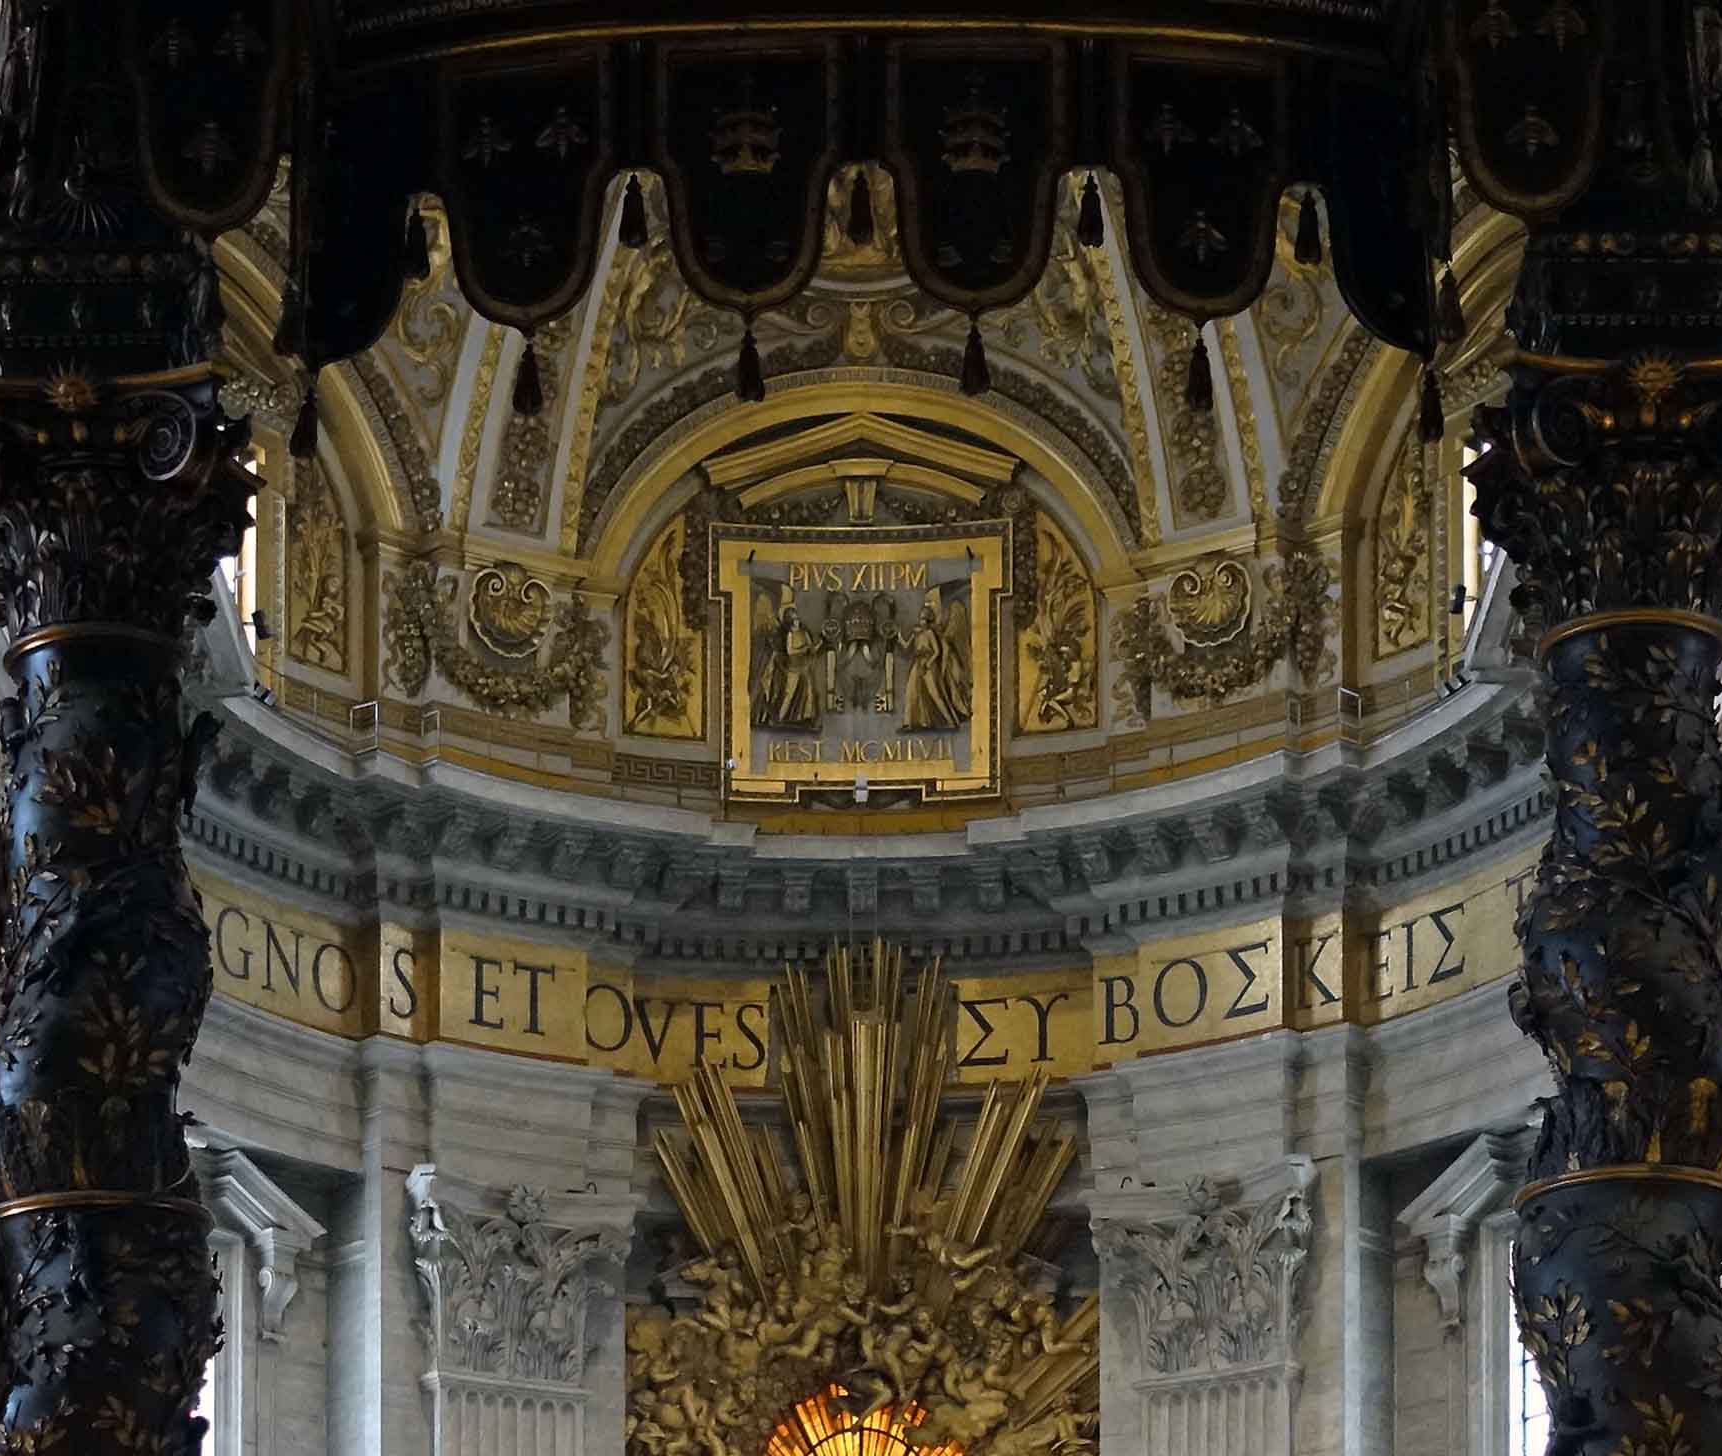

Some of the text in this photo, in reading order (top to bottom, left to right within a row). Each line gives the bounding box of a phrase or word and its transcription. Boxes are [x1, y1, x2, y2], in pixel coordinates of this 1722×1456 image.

[789, 563, 842, 592] PIVS
[468, 953, 556, 1036] ET
[584, 982, 766, 1070] OVES
[957, 993, 1069, 1067] ΣΥ
